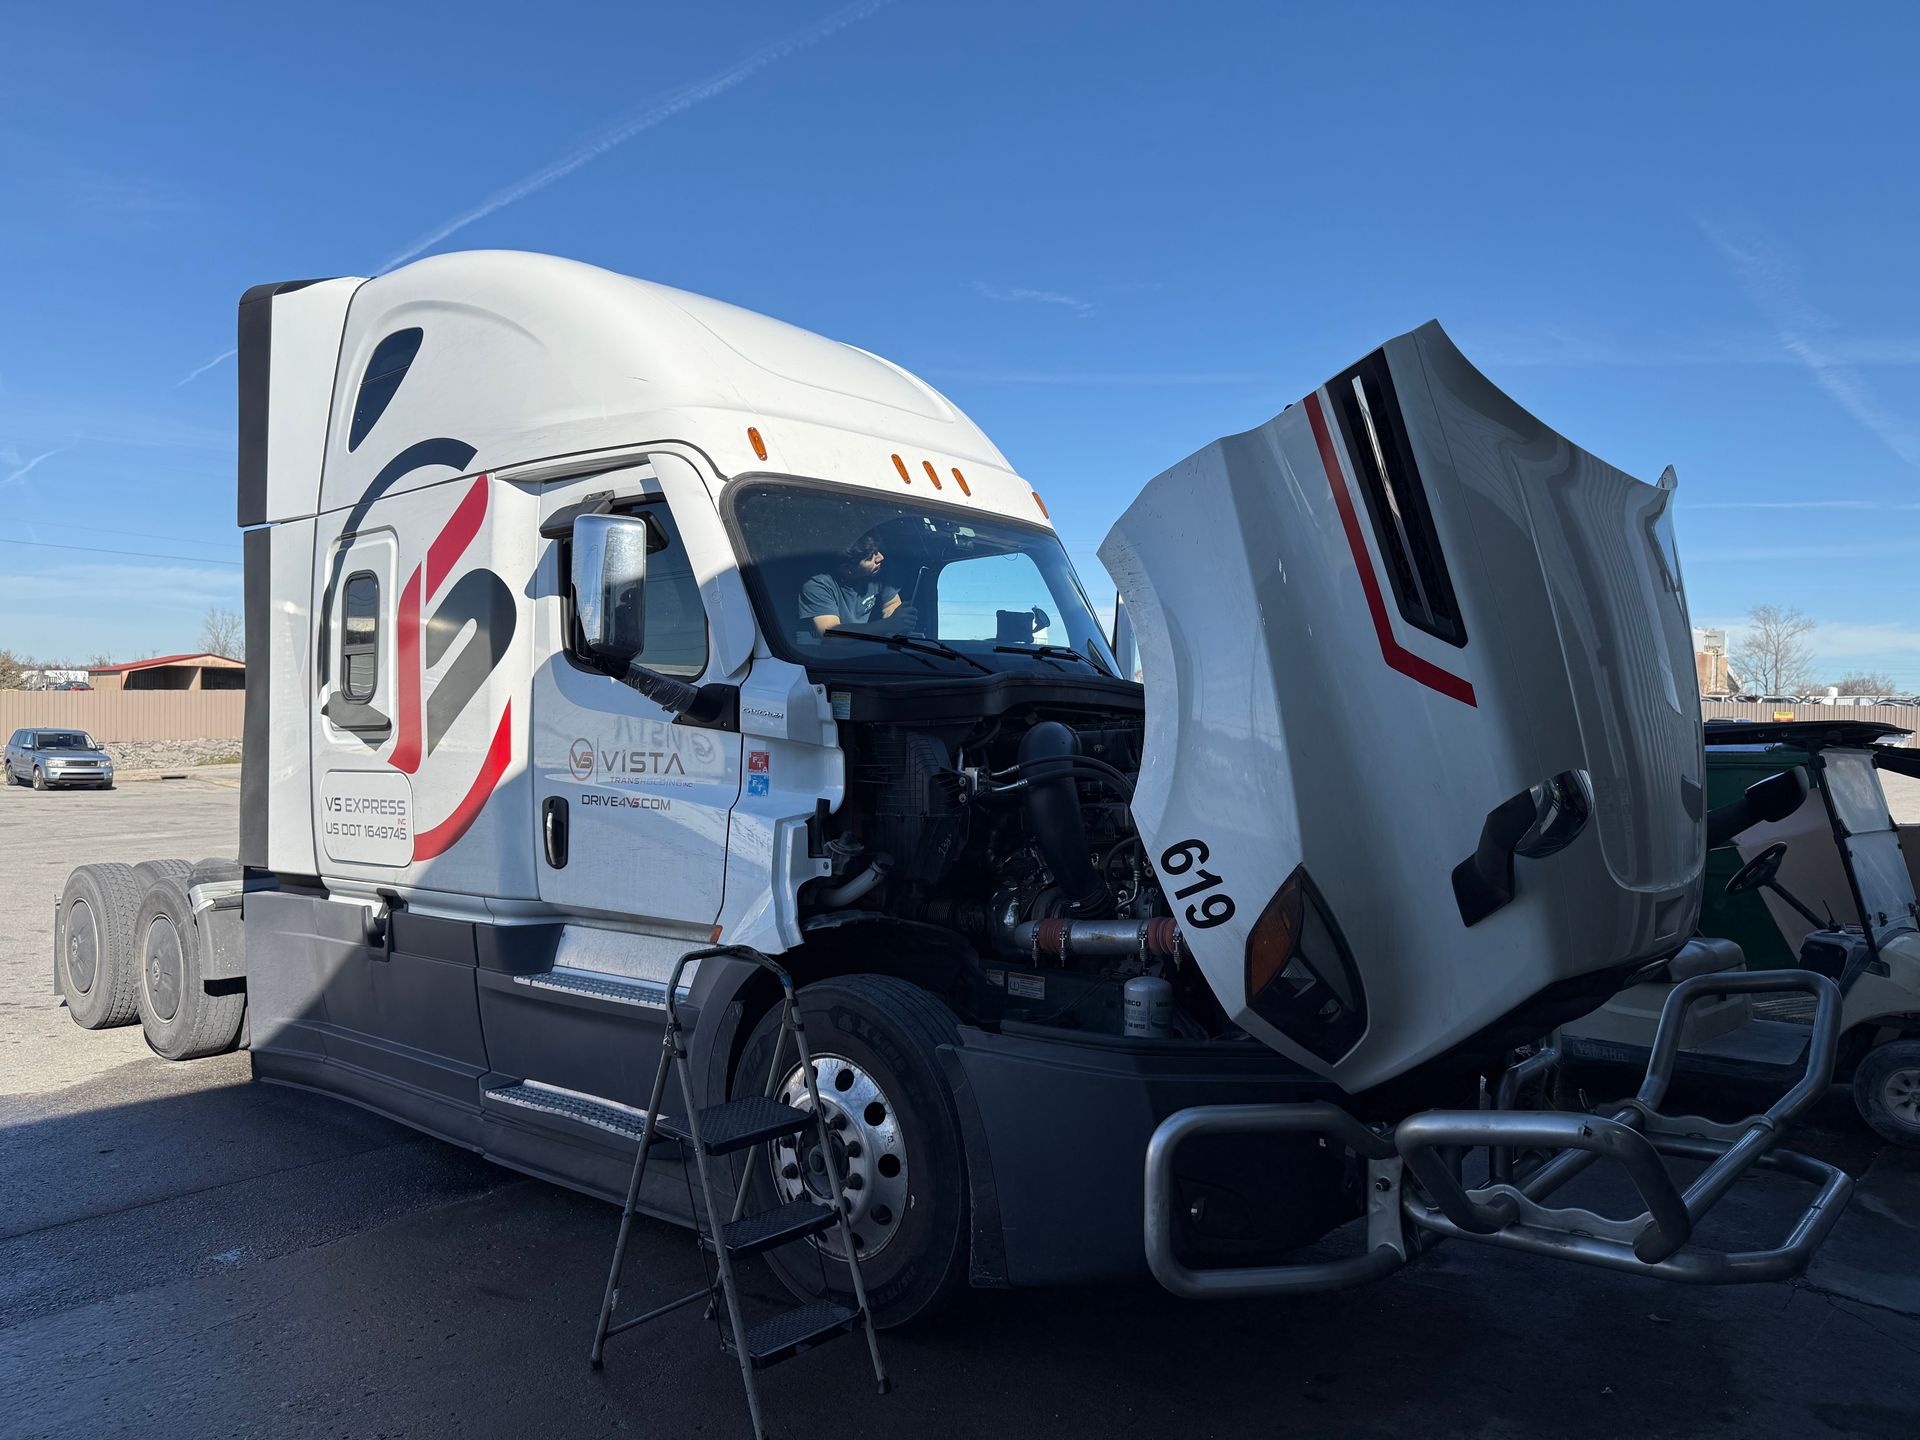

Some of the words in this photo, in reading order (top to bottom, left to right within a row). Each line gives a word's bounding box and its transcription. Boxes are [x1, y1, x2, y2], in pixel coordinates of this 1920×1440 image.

[601, 749, 685, 775] VISTA
[325, 796, 342, 812] VS
[345, 797, 406, 816] EXPRESS
[326, 822, 339, 835] US
[341, 823, 361, 837] DOT
[364, 825, 407, 840] 1649745
[1160, 838, 1236, 929] 619
